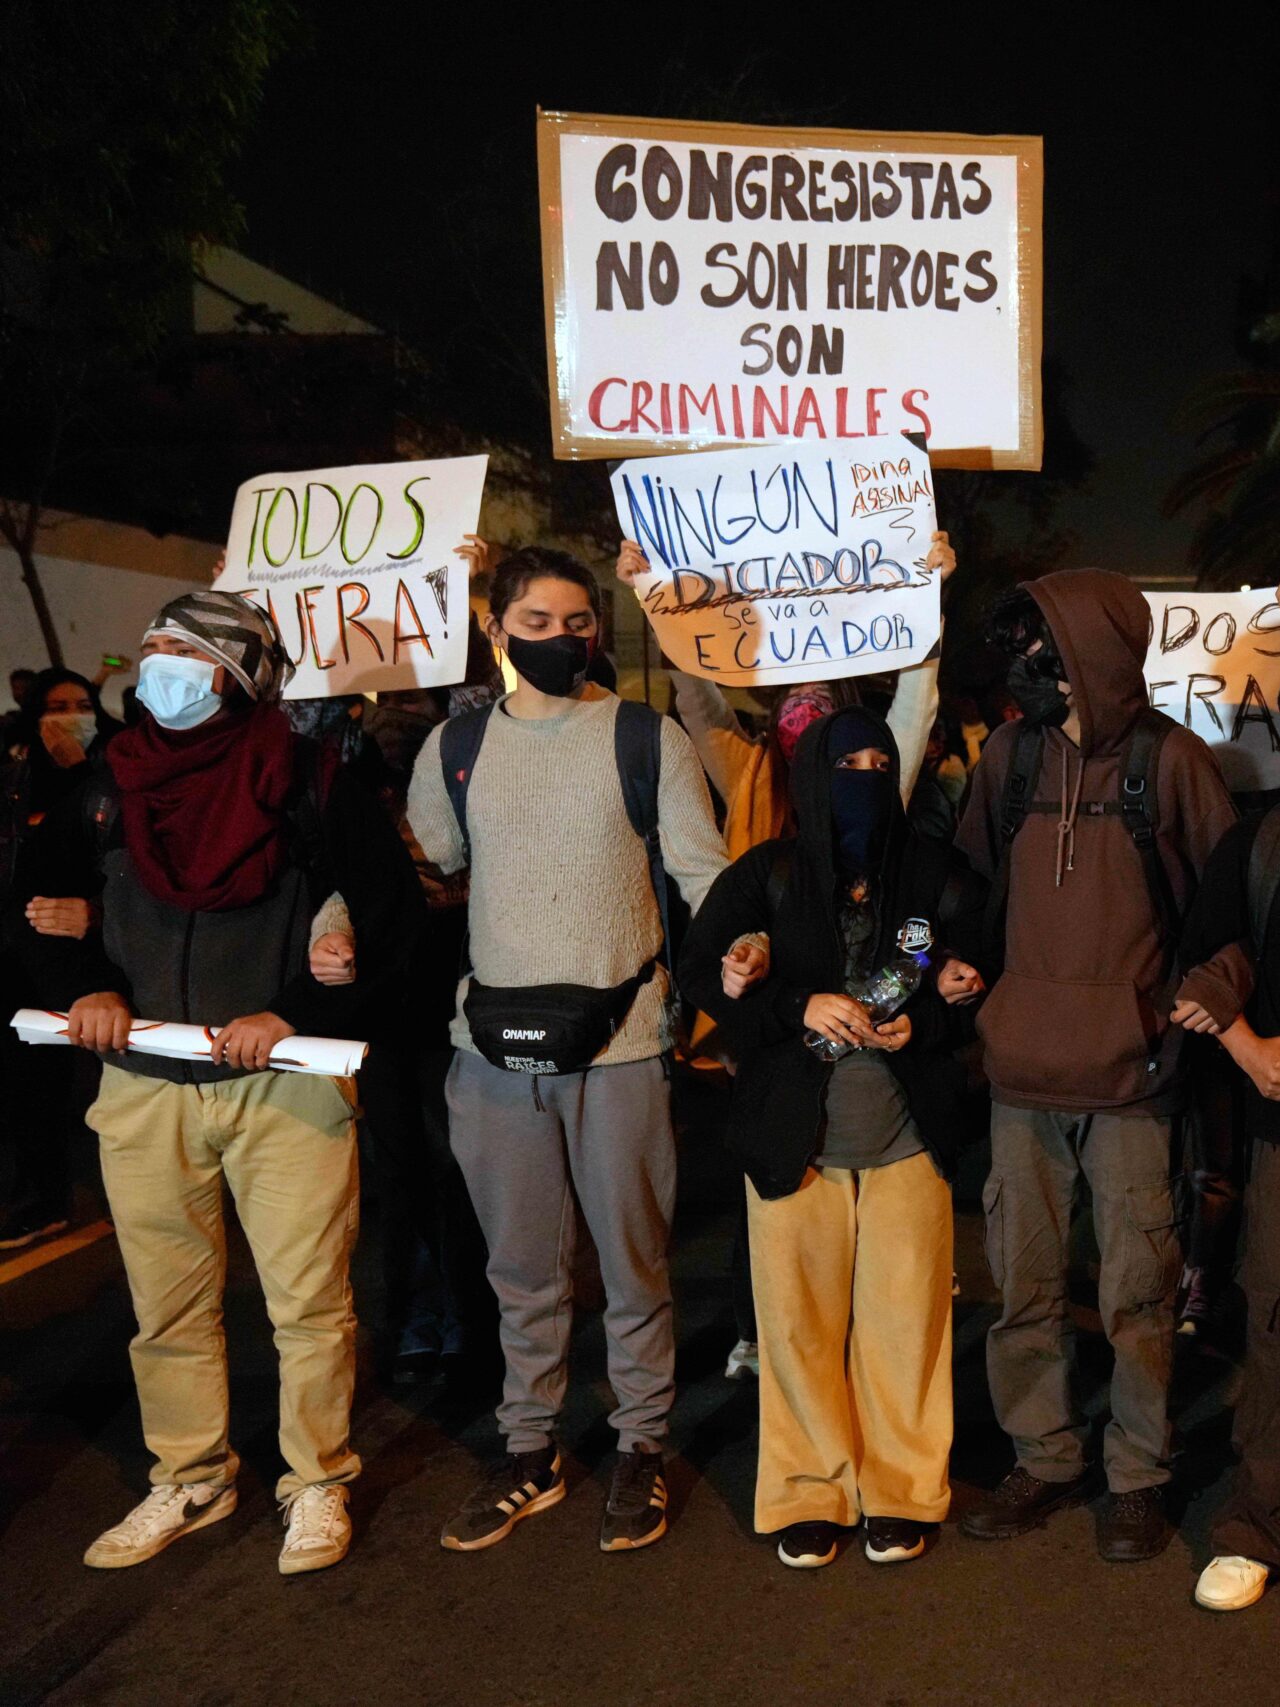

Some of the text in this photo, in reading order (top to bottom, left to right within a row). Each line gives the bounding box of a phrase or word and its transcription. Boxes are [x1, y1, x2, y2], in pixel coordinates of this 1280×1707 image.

[595, 143, 992, 223] CONGRESISTAS
[595, 241, 680, 311] NO
[700, 242, 808, 311] SON
[739, 323, 845, 378] SON
[588, 377, 931, 440] CRIMINALES
[247, 476, 432, 569] TODOS
[671, 539, 911, 605] DICTADOR
[233, 565, 449, 670] UERA!
[768, 601, 797, 620] va
[809, 599, 829, 617] a
[694, 613, 913, 671] ECUADOR
[503, 1028, 546, 1041] ONAMIAP
